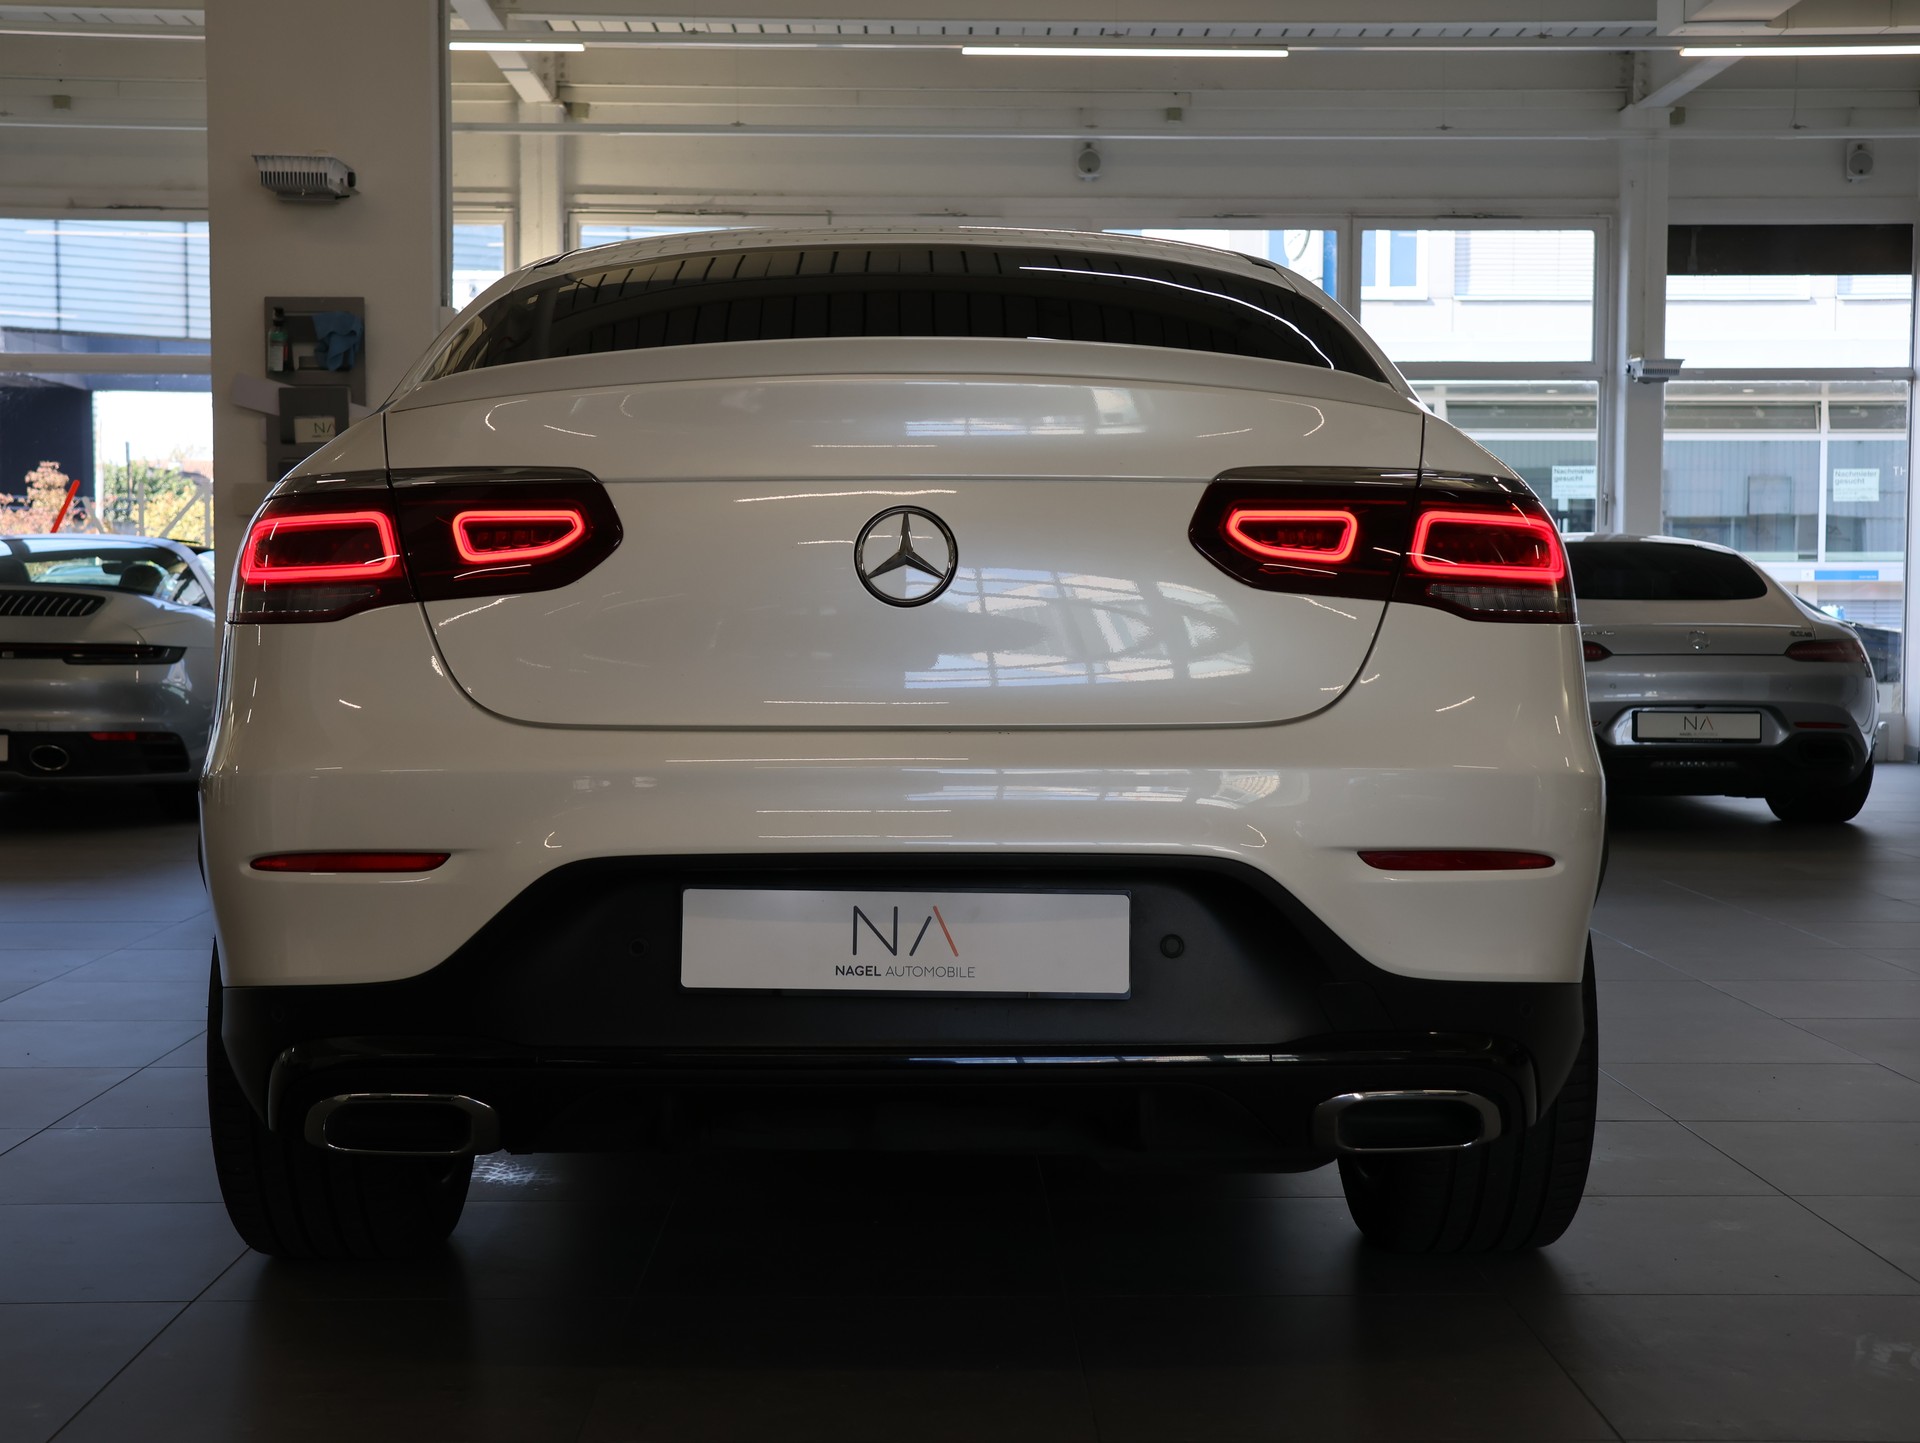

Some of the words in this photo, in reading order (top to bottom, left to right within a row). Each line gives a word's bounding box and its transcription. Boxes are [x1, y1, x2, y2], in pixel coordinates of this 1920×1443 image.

[852, 904, 960, 958] NA
[834, 964, 882, 978] NAGEL
[884, 965, 976, 979] AUTOMOBILE
